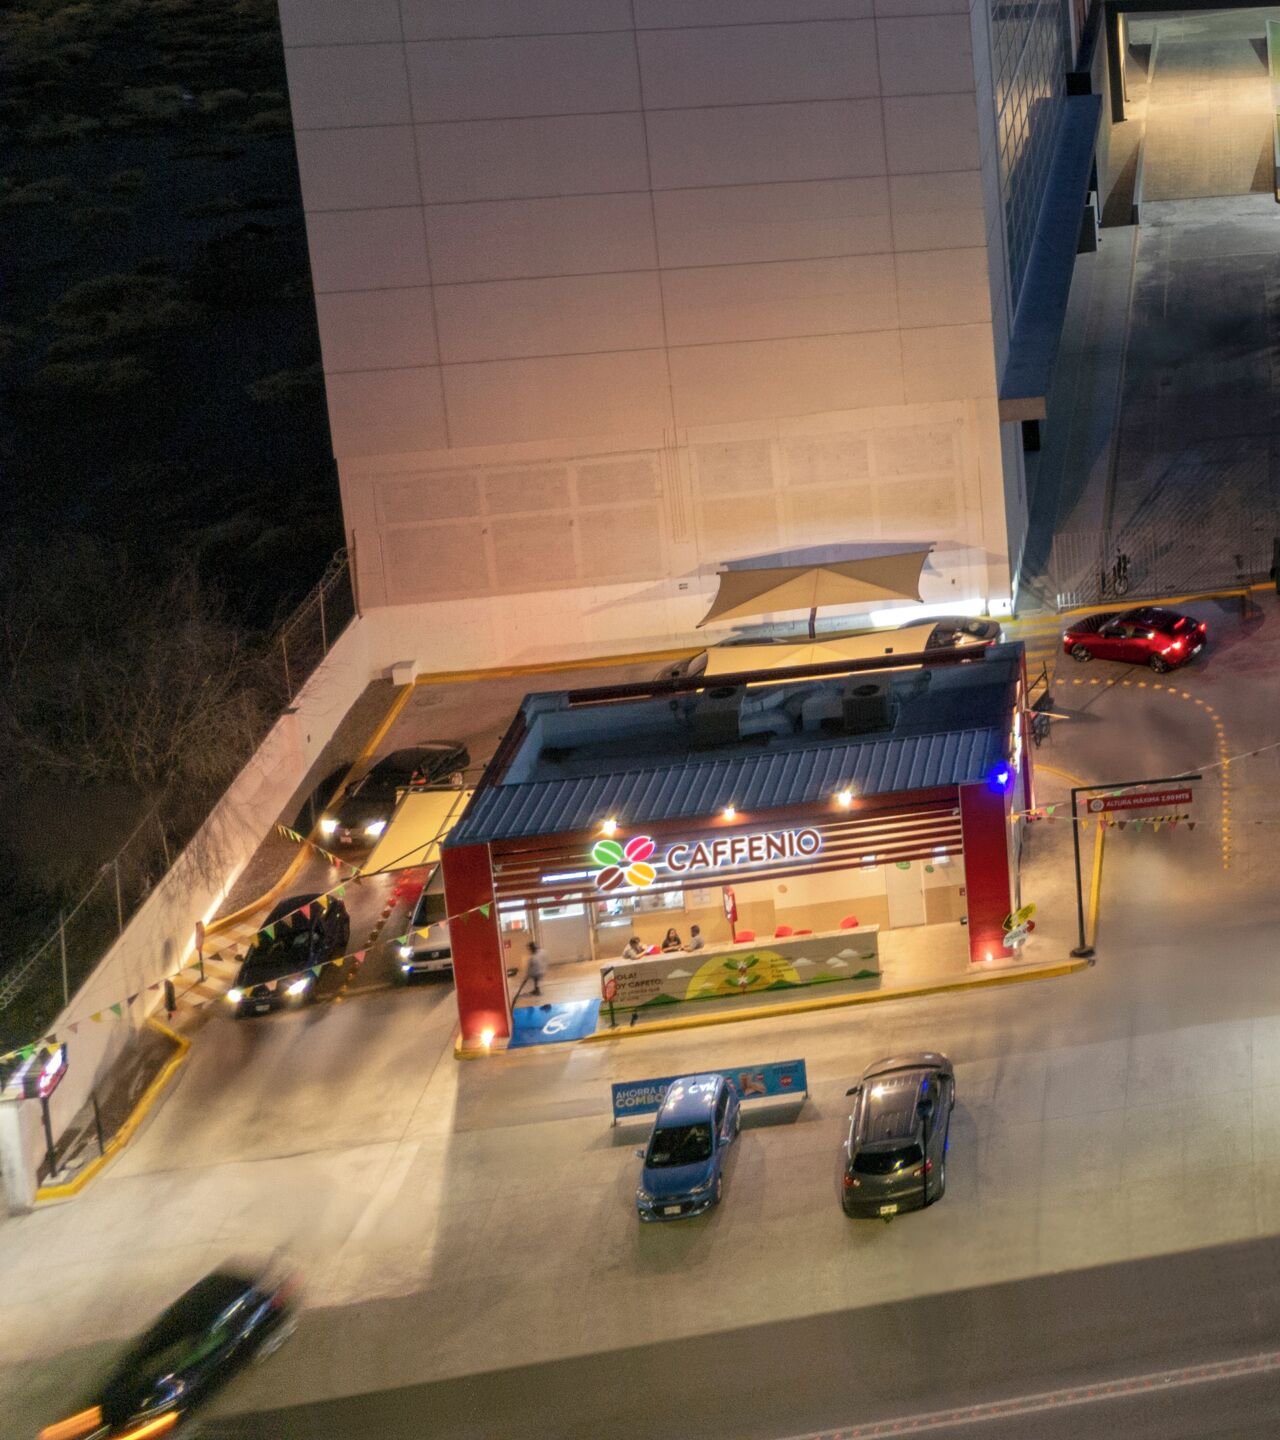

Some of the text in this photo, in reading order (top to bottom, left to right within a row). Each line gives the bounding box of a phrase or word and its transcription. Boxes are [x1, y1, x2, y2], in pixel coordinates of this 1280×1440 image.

[1106, 799, 1131, 807] ALTURA
[666, 828, 822, 872] CAFFENIO
[616, 1086, 657, 1099] AHORRA
